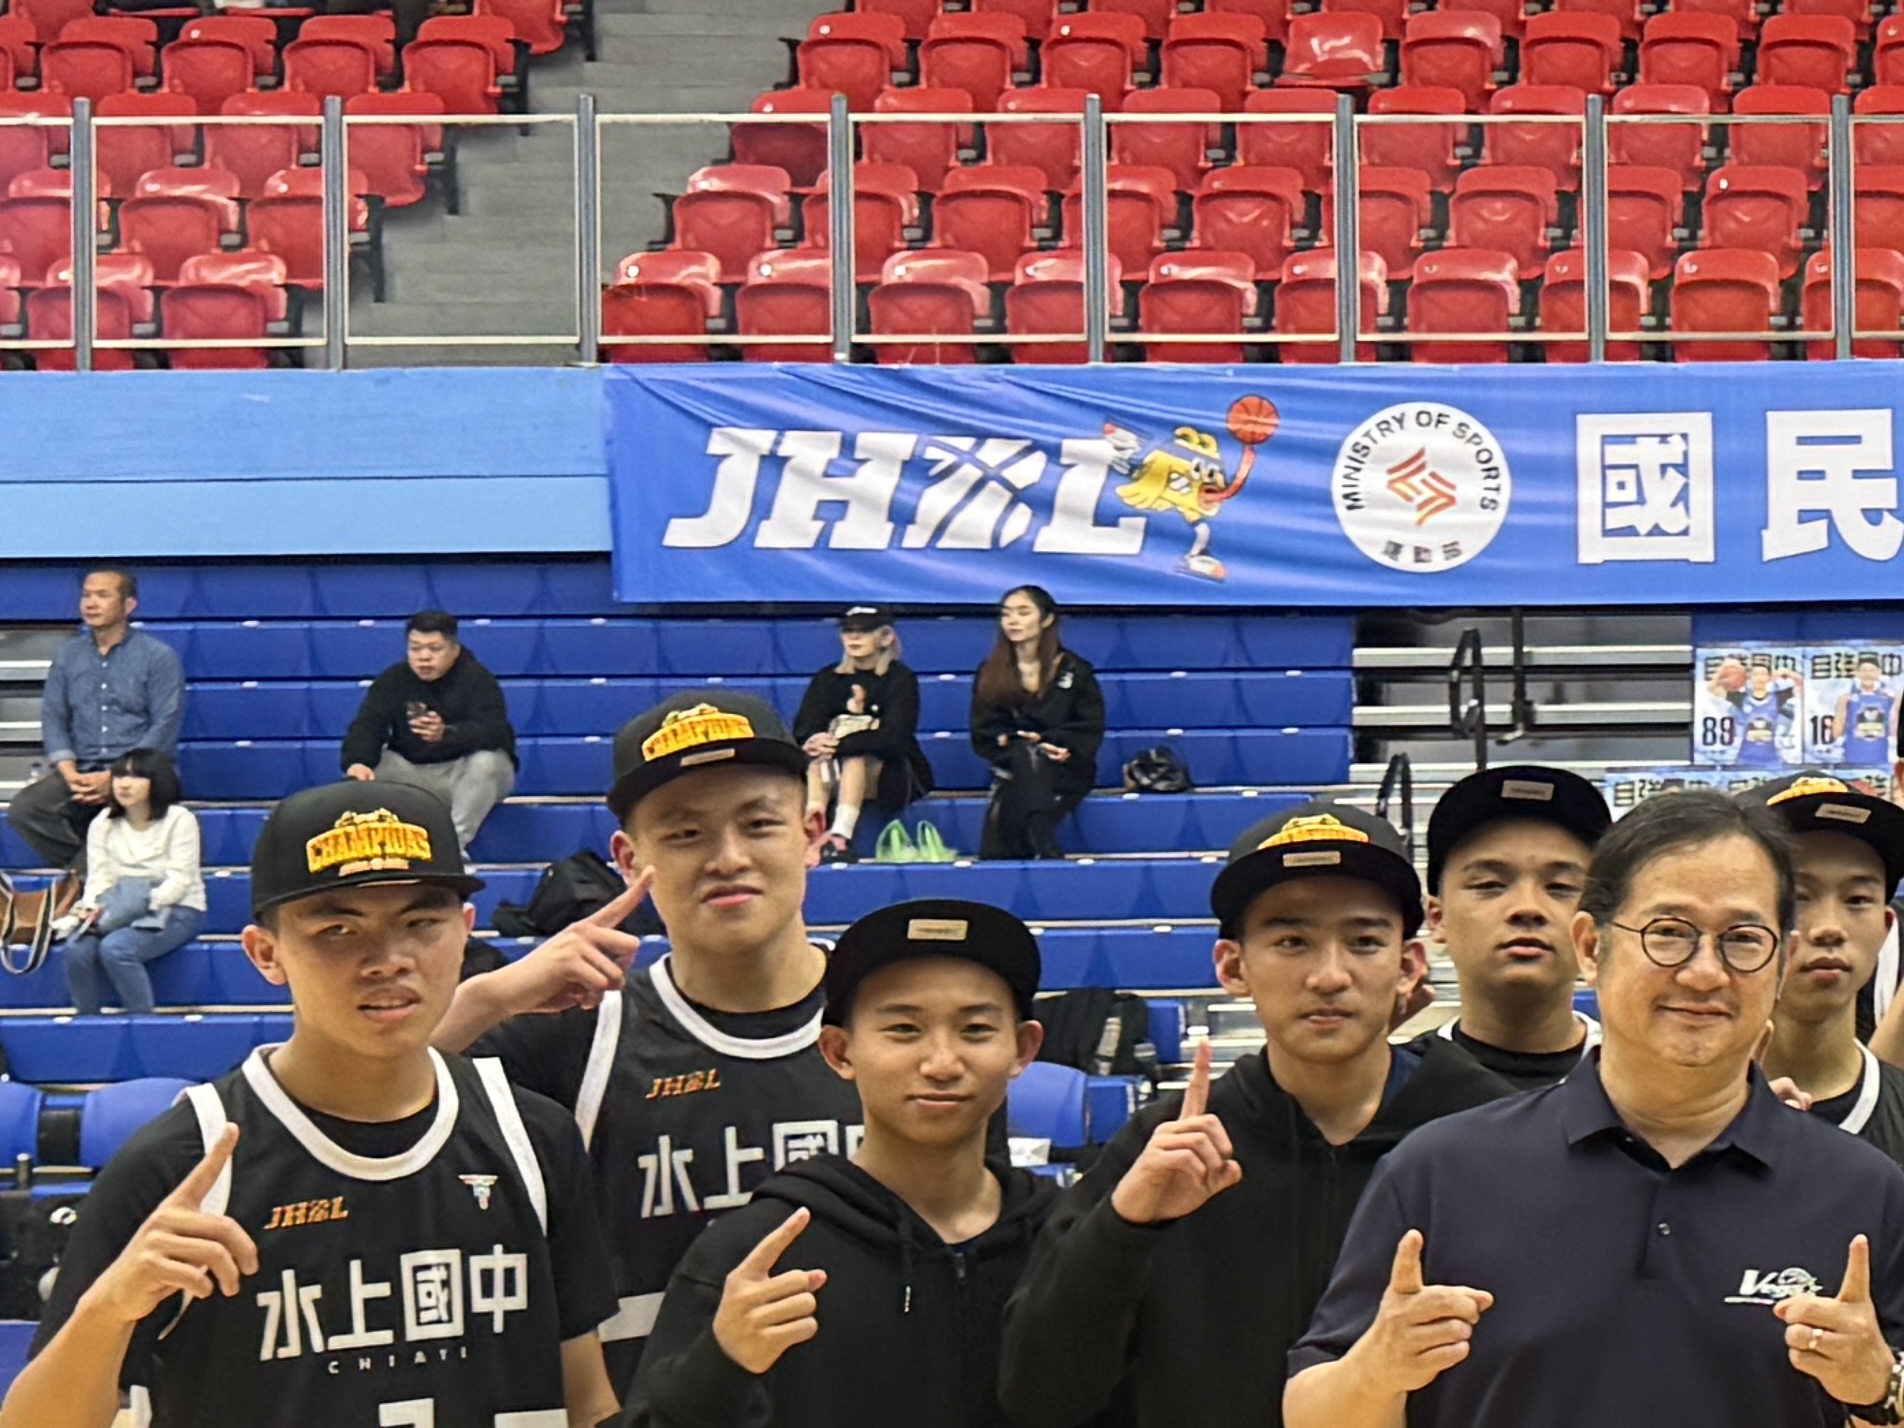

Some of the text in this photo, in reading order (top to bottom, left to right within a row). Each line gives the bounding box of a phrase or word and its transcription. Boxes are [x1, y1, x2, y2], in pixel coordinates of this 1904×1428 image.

[1341, 409, 1503, 512] MINISTRY OF SPORTS
[306, 821, 433, 874] CHAMPIONS
[256, 1243, 528, 1362] 水上國中
